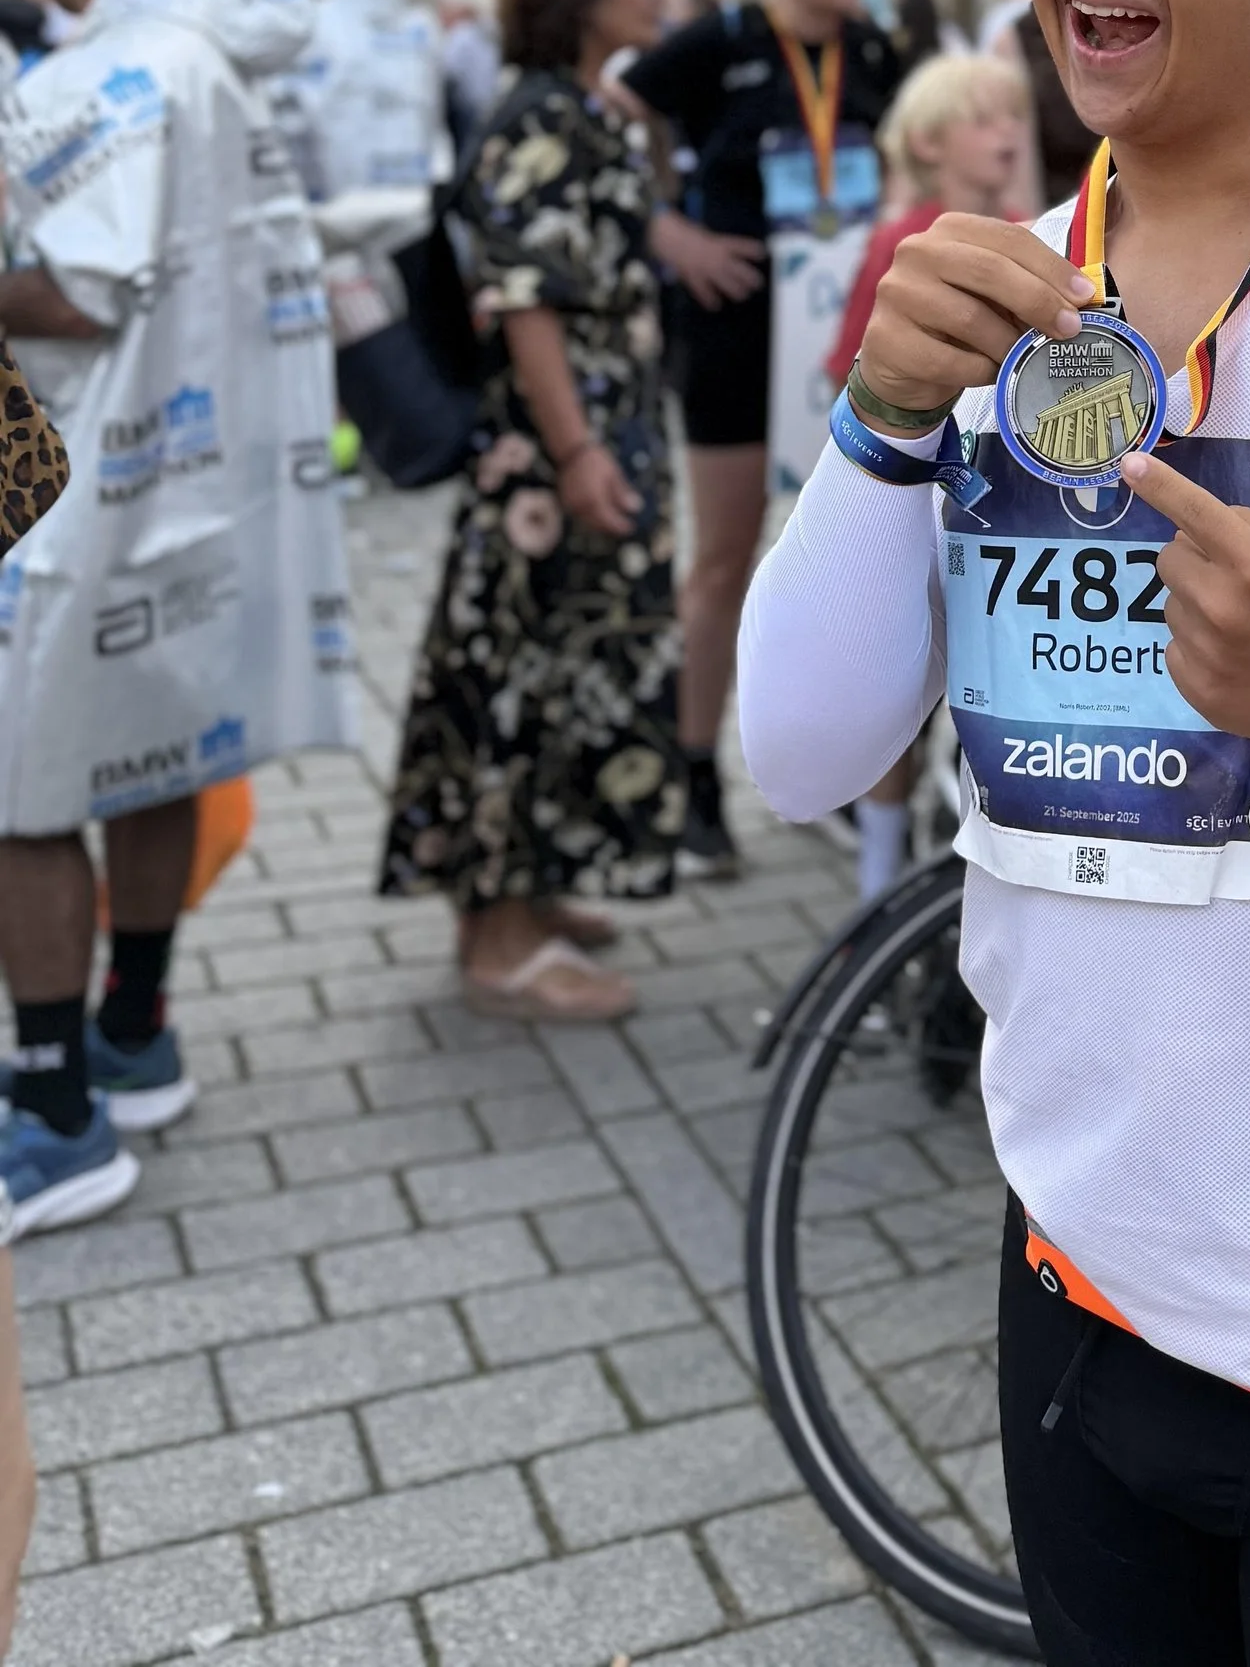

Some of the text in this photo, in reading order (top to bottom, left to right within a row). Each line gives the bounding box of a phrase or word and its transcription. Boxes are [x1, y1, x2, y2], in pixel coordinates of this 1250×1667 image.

[1049, 343, 1090, 357] BMW
[1049, 357, 1090, 367] BERLIN
[1049, 367, 1114, 378] MARATHON
[853, 437, 883, 462] EVENTS
[1042, 470, 1079, 486] BERLIN
[1032, 632, 1165, 676] Robert
[1003, 734, 1188, 787] zalando
[1044, 805, 1140, 824] 21. September 2025
[1185, 815, 1209, 831] SCC
